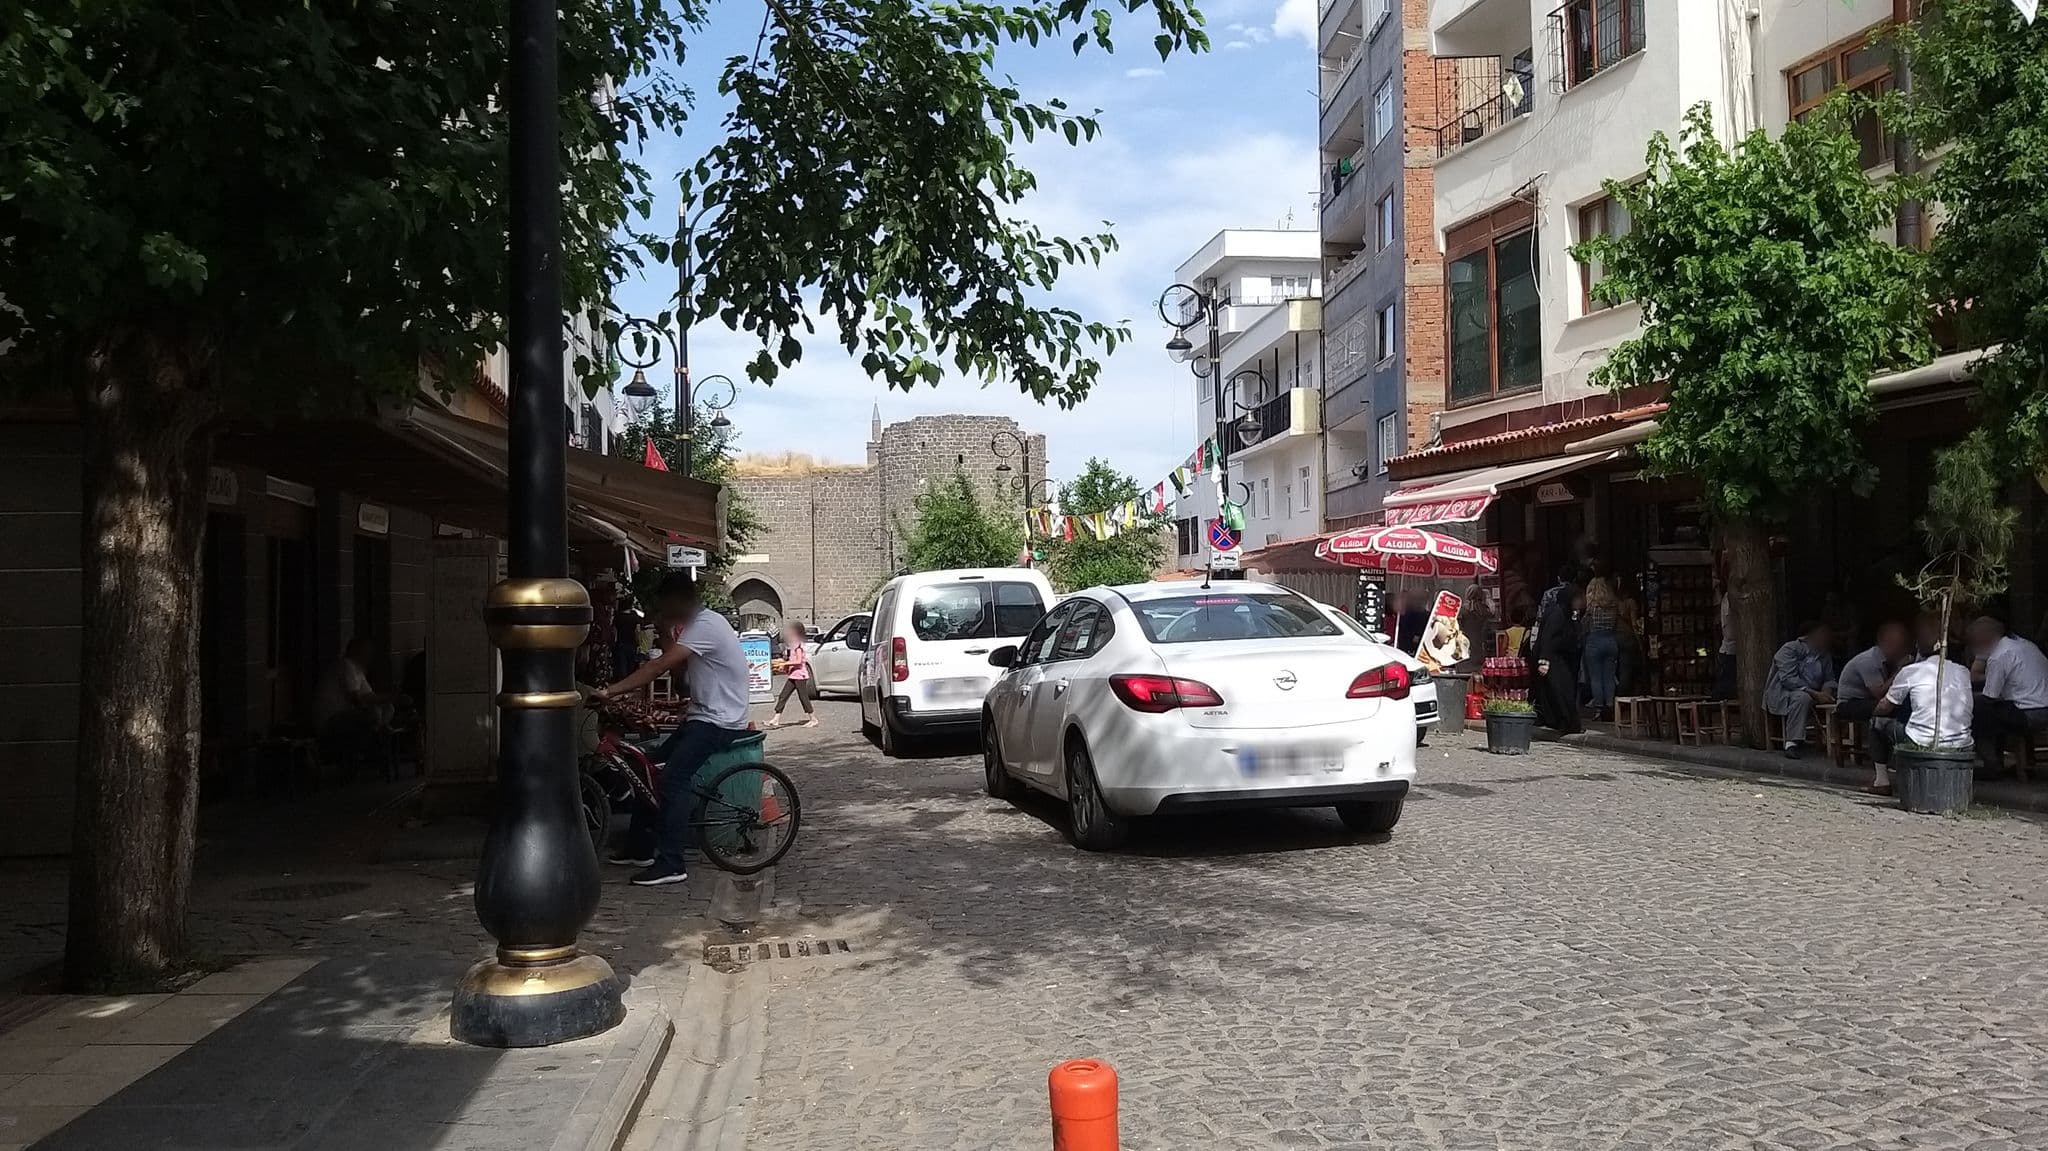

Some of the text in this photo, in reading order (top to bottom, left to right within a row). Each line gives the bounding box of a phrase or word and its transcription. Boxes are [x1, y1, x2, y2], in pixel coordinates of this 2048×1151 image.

[1339, 540, 1364, 548] ALGIDA
[1385, 540, 1418, 549] ALGIDA
[1442, 545, 1470, 557] ALGIDA
